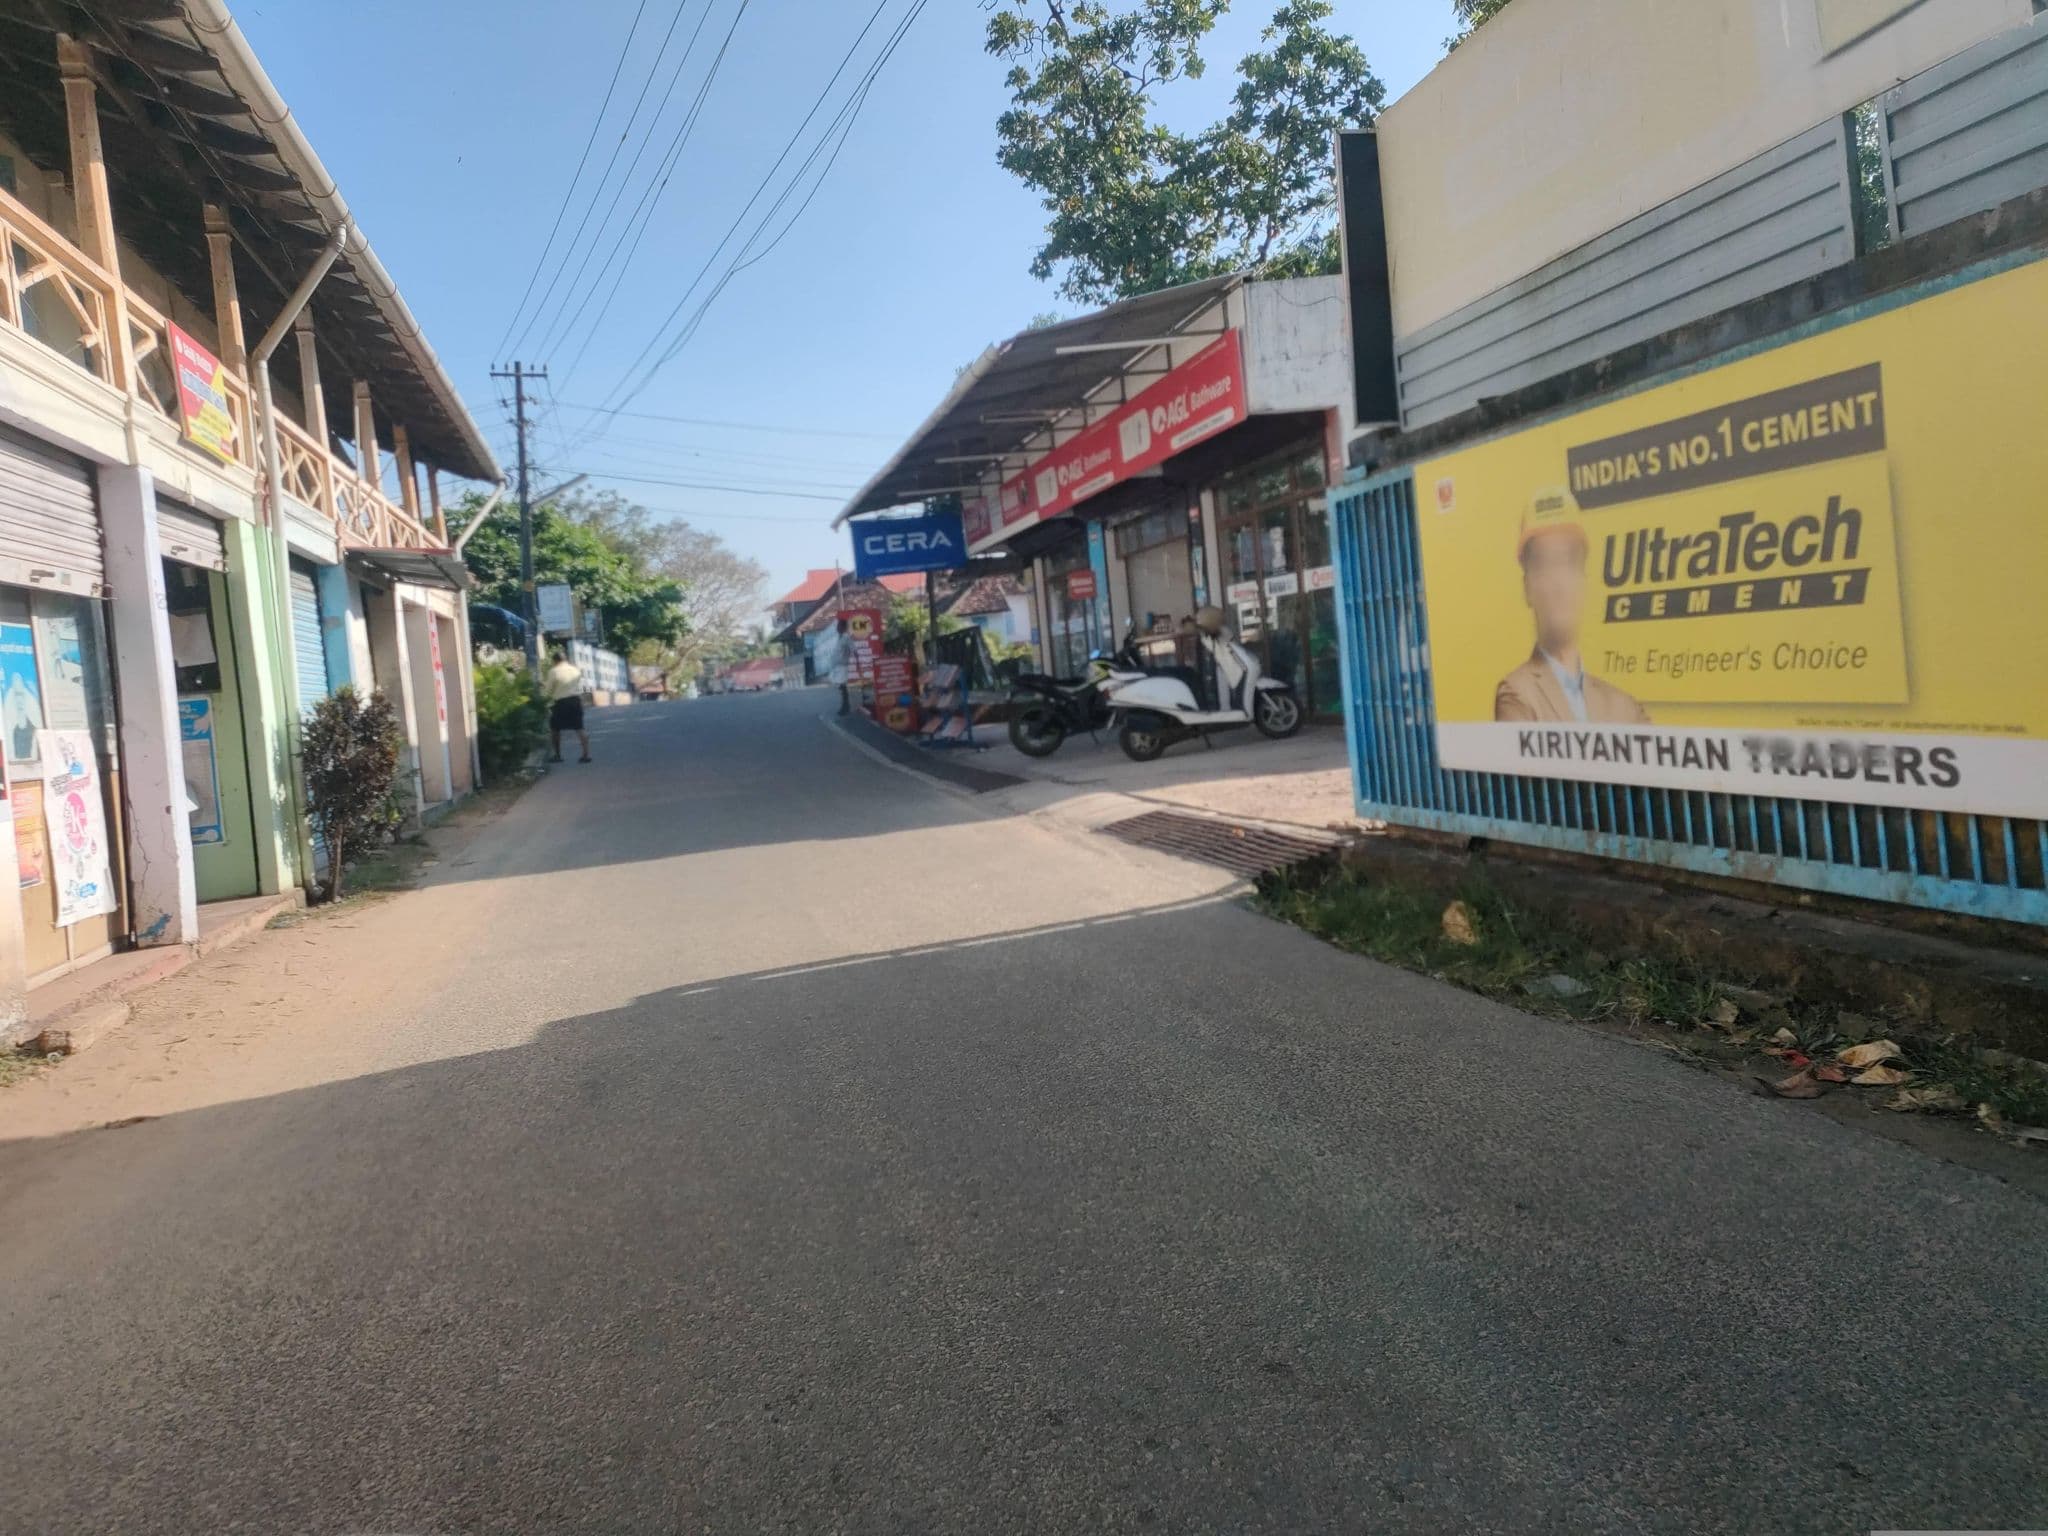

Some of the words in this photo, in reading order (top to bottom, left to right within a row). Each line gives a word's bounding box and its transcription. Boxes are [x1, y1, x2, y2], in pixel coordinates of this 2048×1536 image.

[1573, 446, 1662, 491] INDIA'S
[1741, 392, 1878, 453] CEMENT
[864, 530, 952, 555] CERA
[1603, 495, 1862, 588] UltraTech
[1613, 575, 1852, 619] CEMENT
[1604, 651, 1637, 674] The
[1646, 647, 1761, 679] Engineer's
[1774, 641, 1868, 671] Choice
[1518, 730, 1730, 771] KIRIYANTHAN
[1742, 737, 1961, 788] TRADERS
